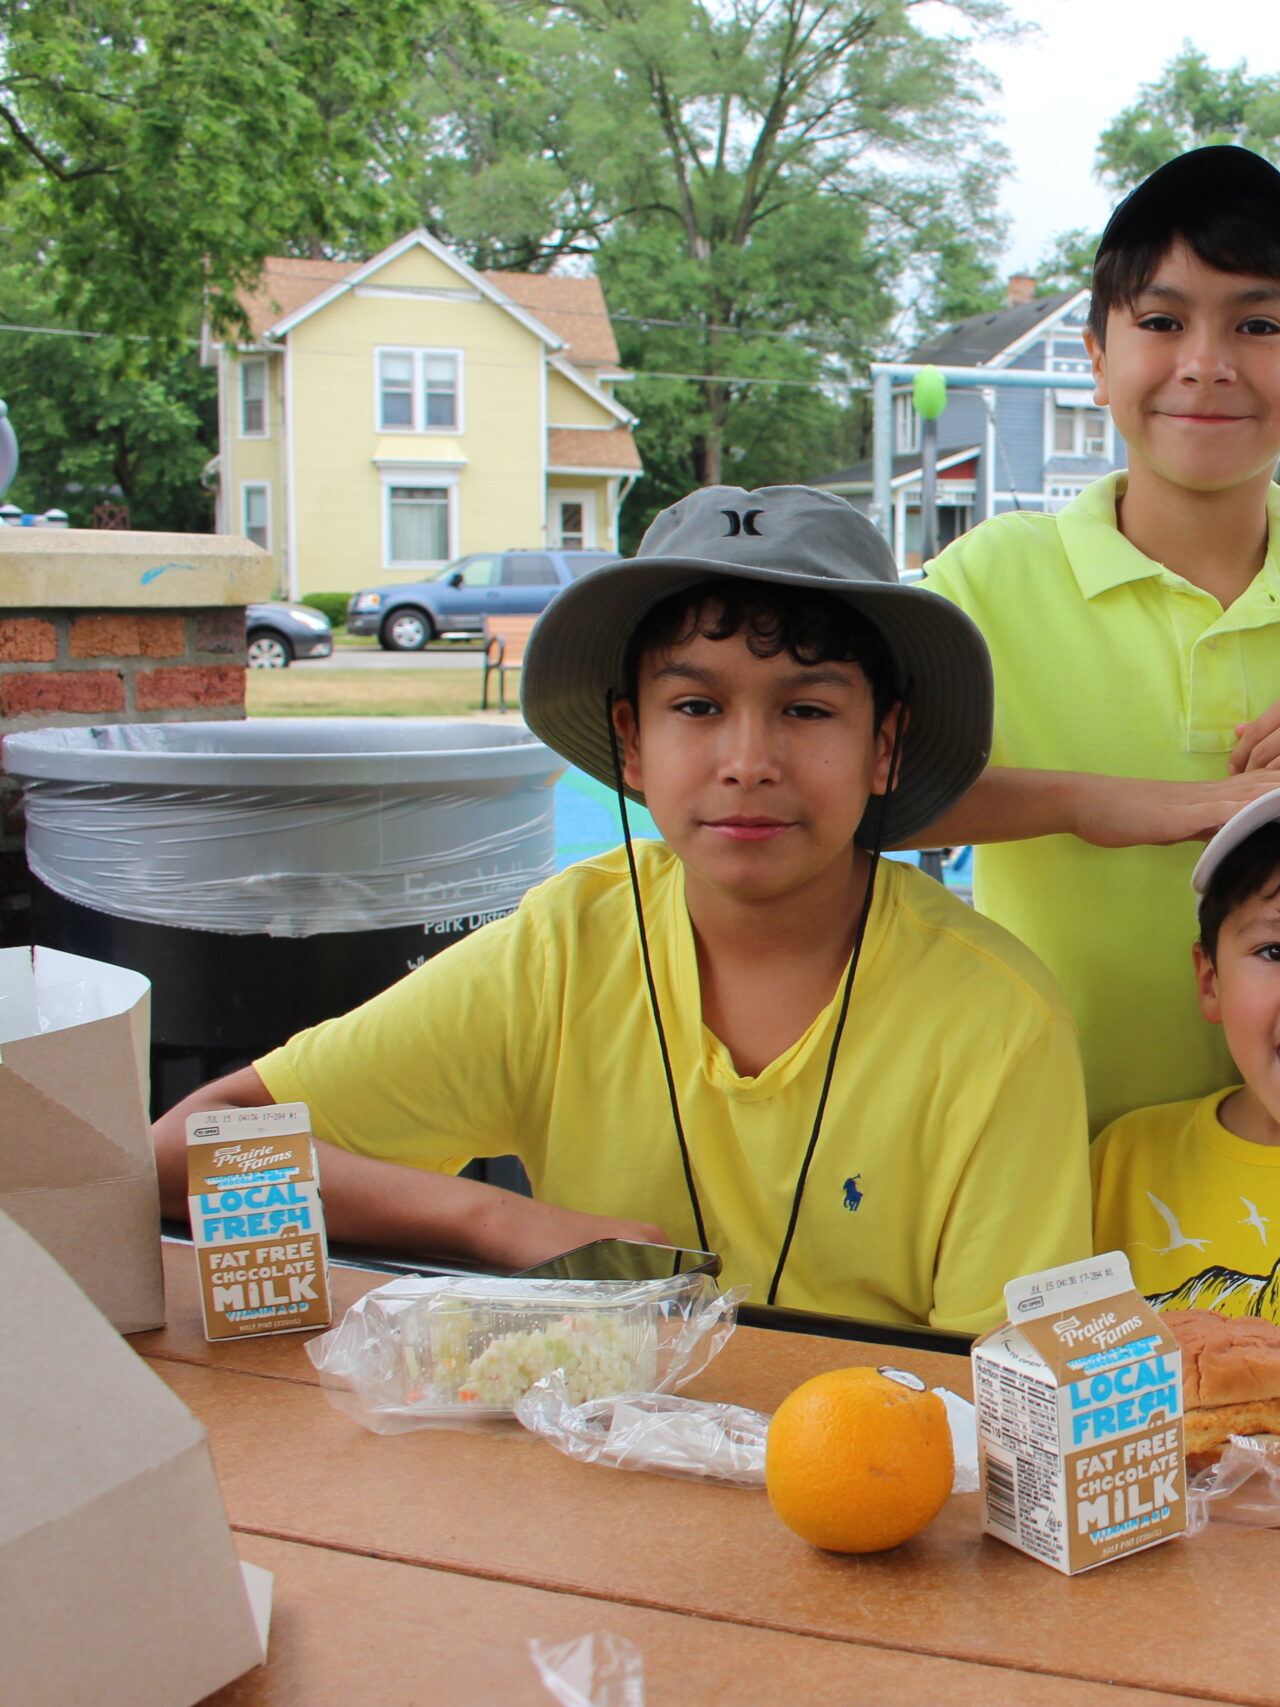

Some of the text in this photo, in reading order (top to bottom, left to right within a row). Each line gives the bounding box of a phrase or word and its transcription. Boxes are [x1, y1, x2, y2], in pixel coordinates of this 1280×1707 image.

[424, 915, 464, 935] Park
[213, 1145, 274, 1168] Prairie
[238, 1150, 293, 1173] Farms
[200, 1183, 308, 1215] LOCAL
[203, 1207, 311, 1242] FRESH
[209, 1241, 315, 1270] FAT FREE
[211, 1260, 316, 1285] CHOCOLATE
[212, 1273, 319, 1312] MILK
[225, 1306, 276, 1322] VITAMIN
[1060, 1312, 1117, 1348] Prairie
[1092, 1315, 1143, 1350] Farms
[1070, 1355, 1176, 1410] LOCAL
[1073, 1384, 1177, 1445] FRESH
[1076, 1448, 1118, 1480] FAT
[1123, 1428, 1178, 1465] FREE
[1077, 1451, 1178, 1498] CHOCOLATE
[1077, 1469, 1179, 1535] MILK
[1089, 1518, 1139, 1546] VITAMIN
